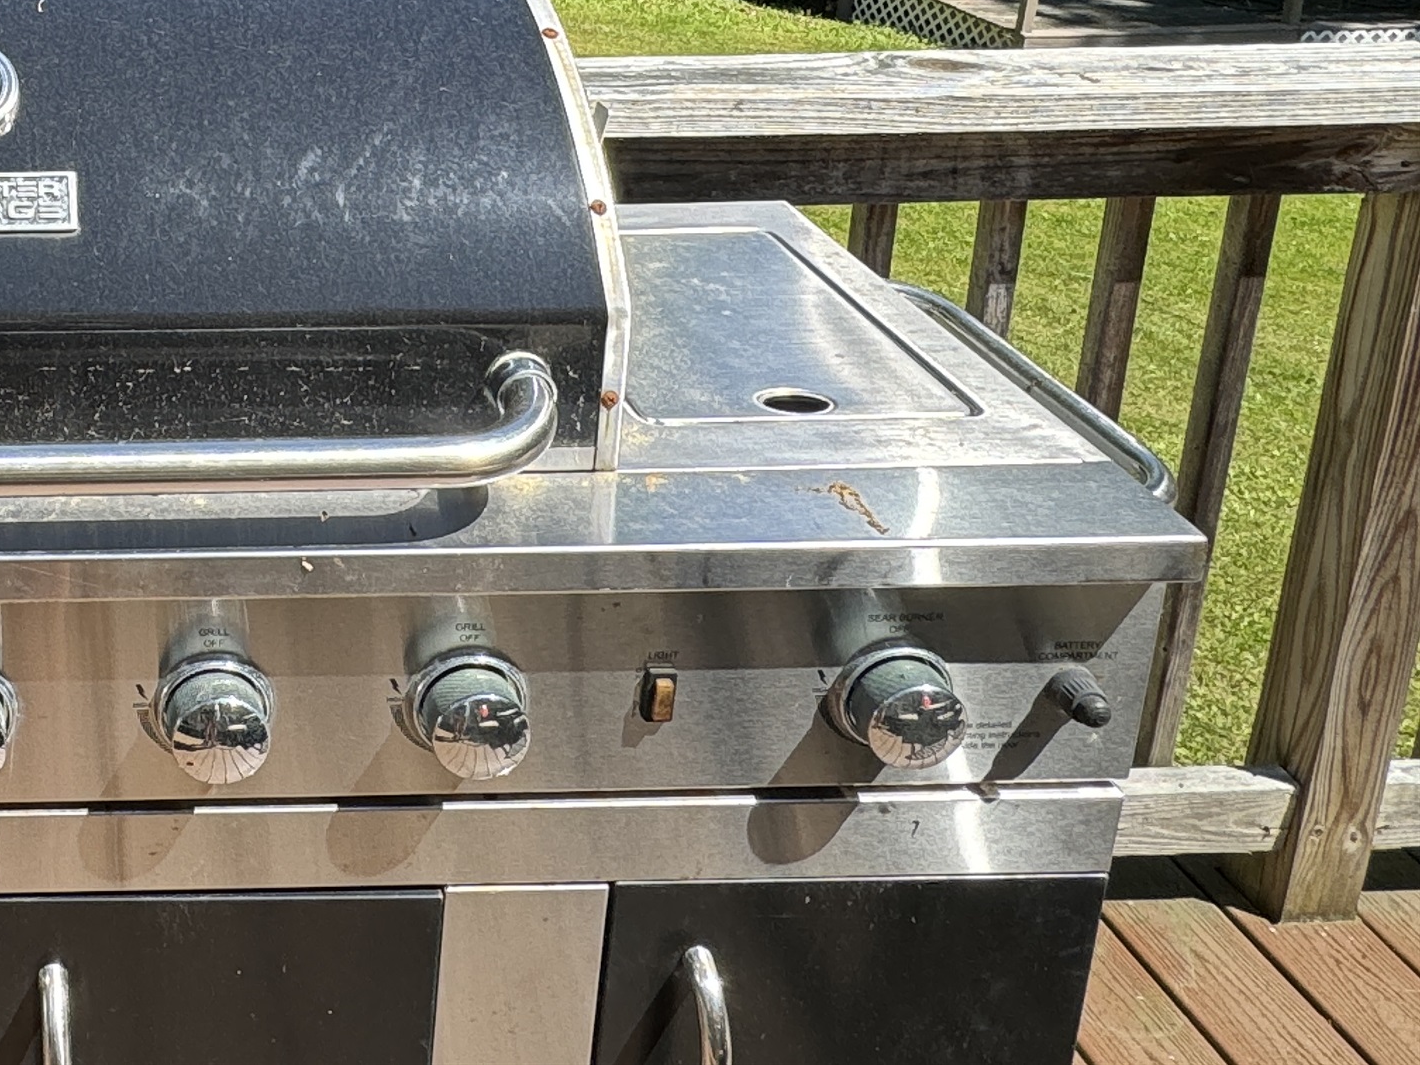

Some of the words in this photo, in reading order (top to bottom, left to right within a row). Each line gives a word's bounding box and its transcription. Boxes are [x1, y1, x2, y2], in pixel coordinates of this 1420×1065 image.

[867, 614, 897, 623] SEAR
[455, 623, 487, 632] GRILL
[198, 628, 230, 637] GRILL
[460, 634, 481, 643] OFF
[203, 639, 225, 648] OFF
[1054, 641, 1102, 650] BATTERY
[647, 650, 680, 660] LIGHT
